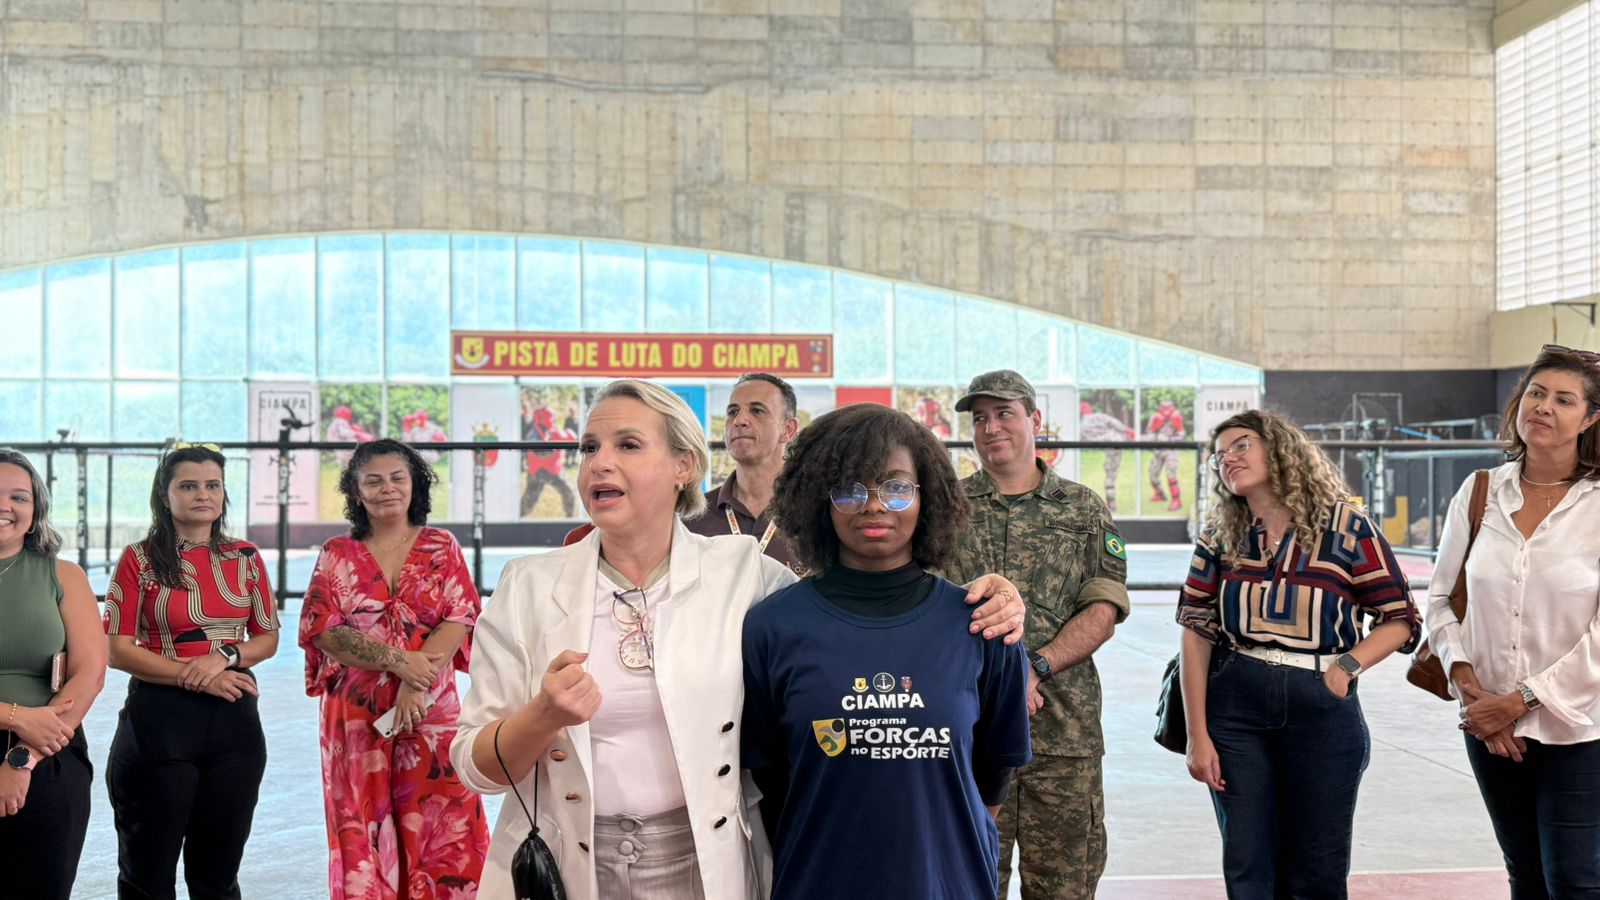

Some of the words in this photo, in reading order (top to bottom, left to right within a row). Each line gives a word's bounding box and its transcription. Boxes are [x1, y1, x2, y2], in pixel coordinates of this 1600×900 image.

[494, 340, 560, 367] PISTA
[570, 341, 598, 367] DE
[609, 342, 662, 368] LUTA
[673, 342, 701, 368] DO
[713, 343, 799, 369] CIAMPA
[1206, 401, 1249, 412] CIAMPA
[841, 693, 925, 711] CIAMPA
[849, 718, 907, 727] Programa
[851, 747, 868, 755] no
